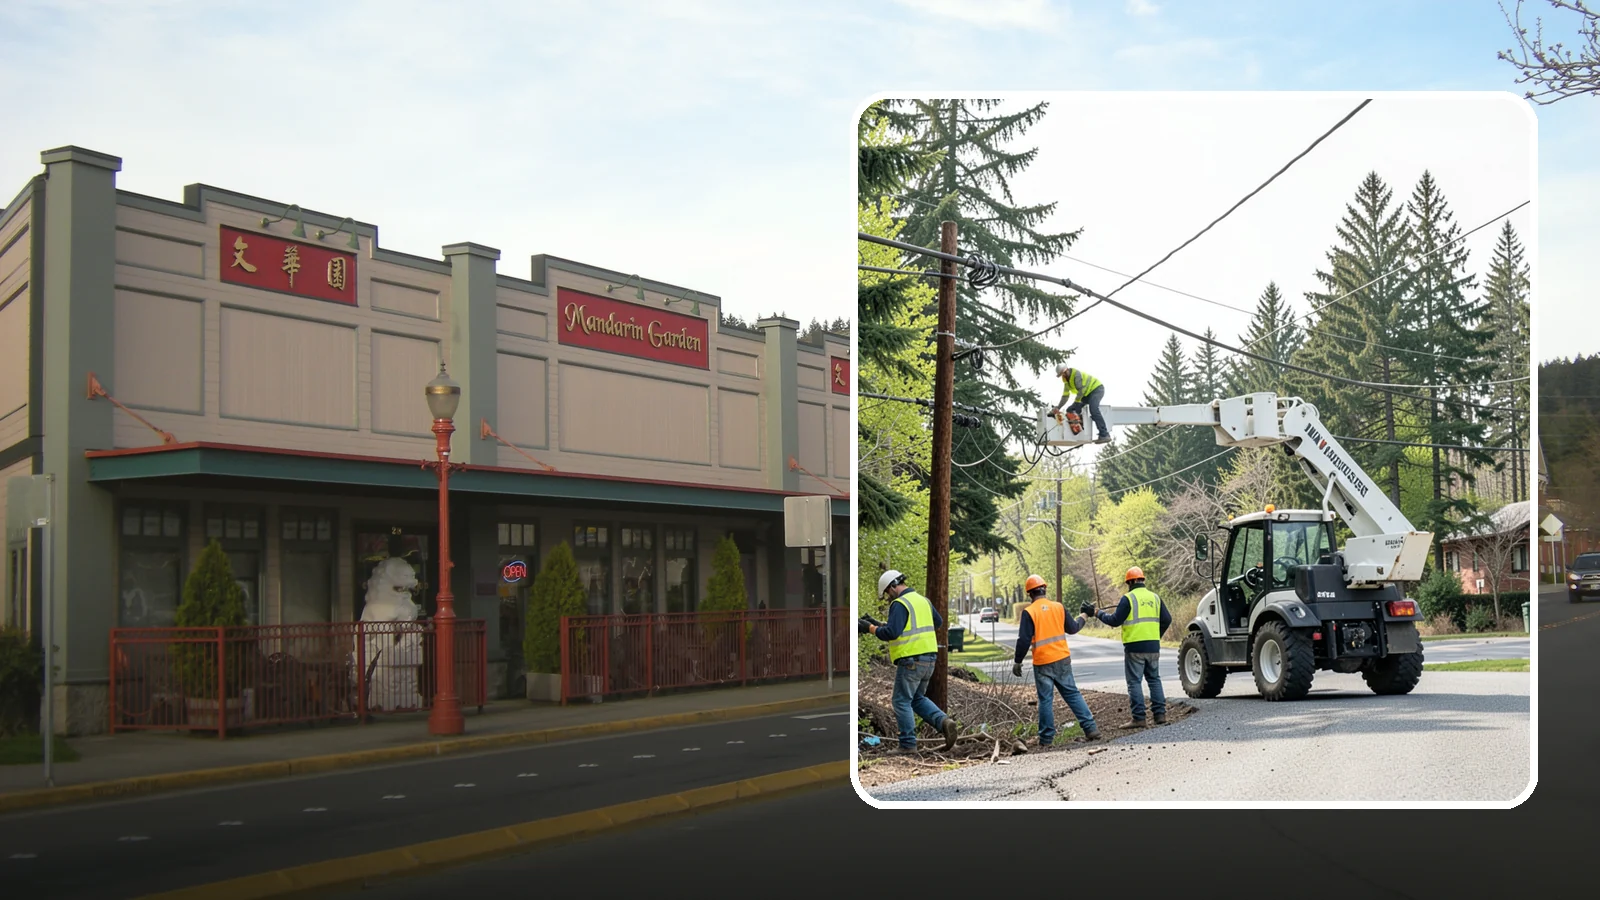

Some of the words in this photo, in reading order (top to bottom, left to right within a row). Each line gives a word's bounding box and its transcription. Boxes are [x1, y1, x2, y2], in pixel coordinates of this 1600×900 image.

[231, 236, 346, 290] 文華園
[564, 302, 644, 341] Mandarin
[648, 320, 702, 352] Garden
[503, 565, 526, 578] OPEN
